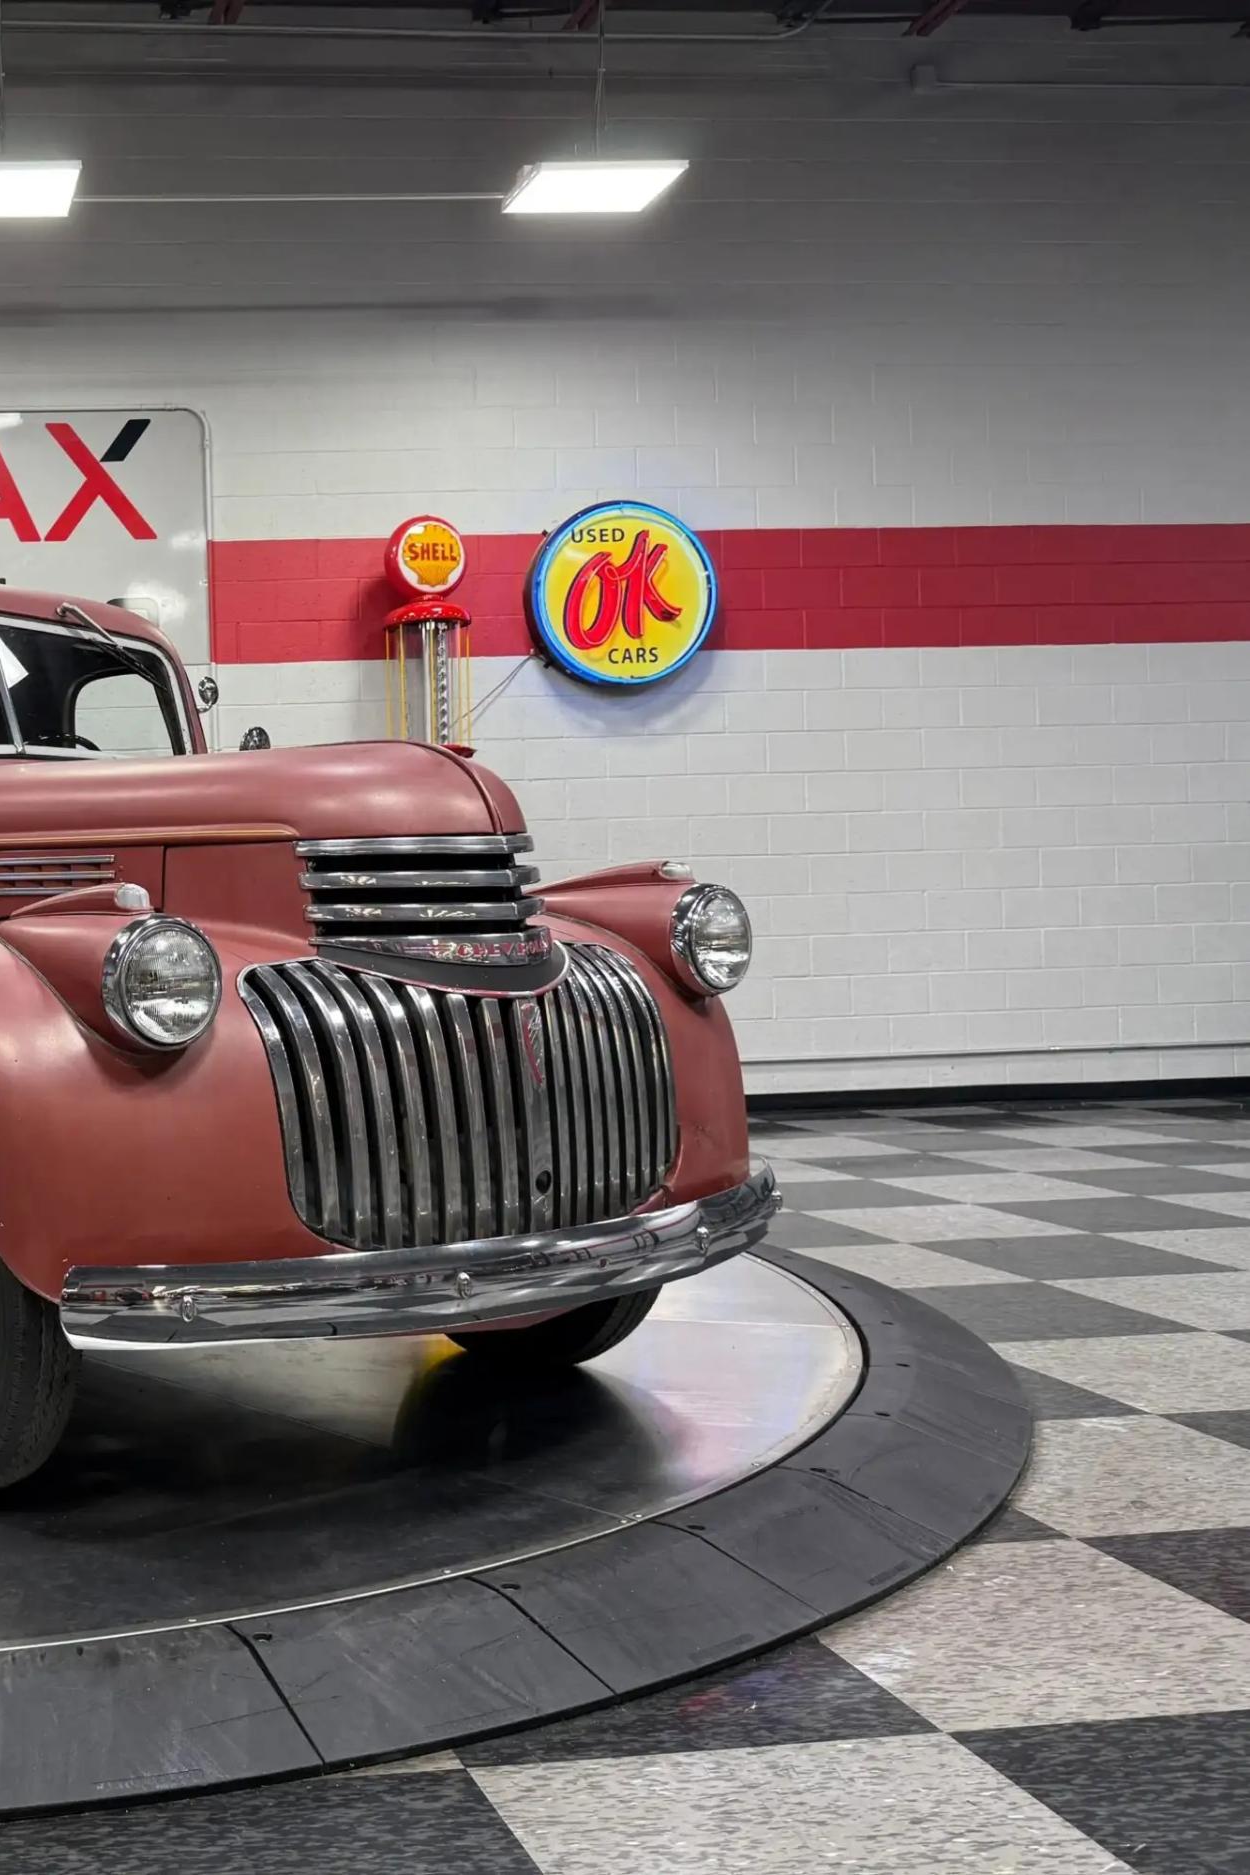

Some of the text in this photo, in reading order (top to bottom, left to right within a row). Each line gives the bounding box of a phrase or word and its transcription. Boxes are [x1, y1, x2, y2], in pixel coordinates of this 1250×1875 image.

[571, 528, 625, 543] USED
[408, 542, 458, 562] SHELL
[563, 529, 683, 650] OK
[608, 647, 659, 664] CARS
